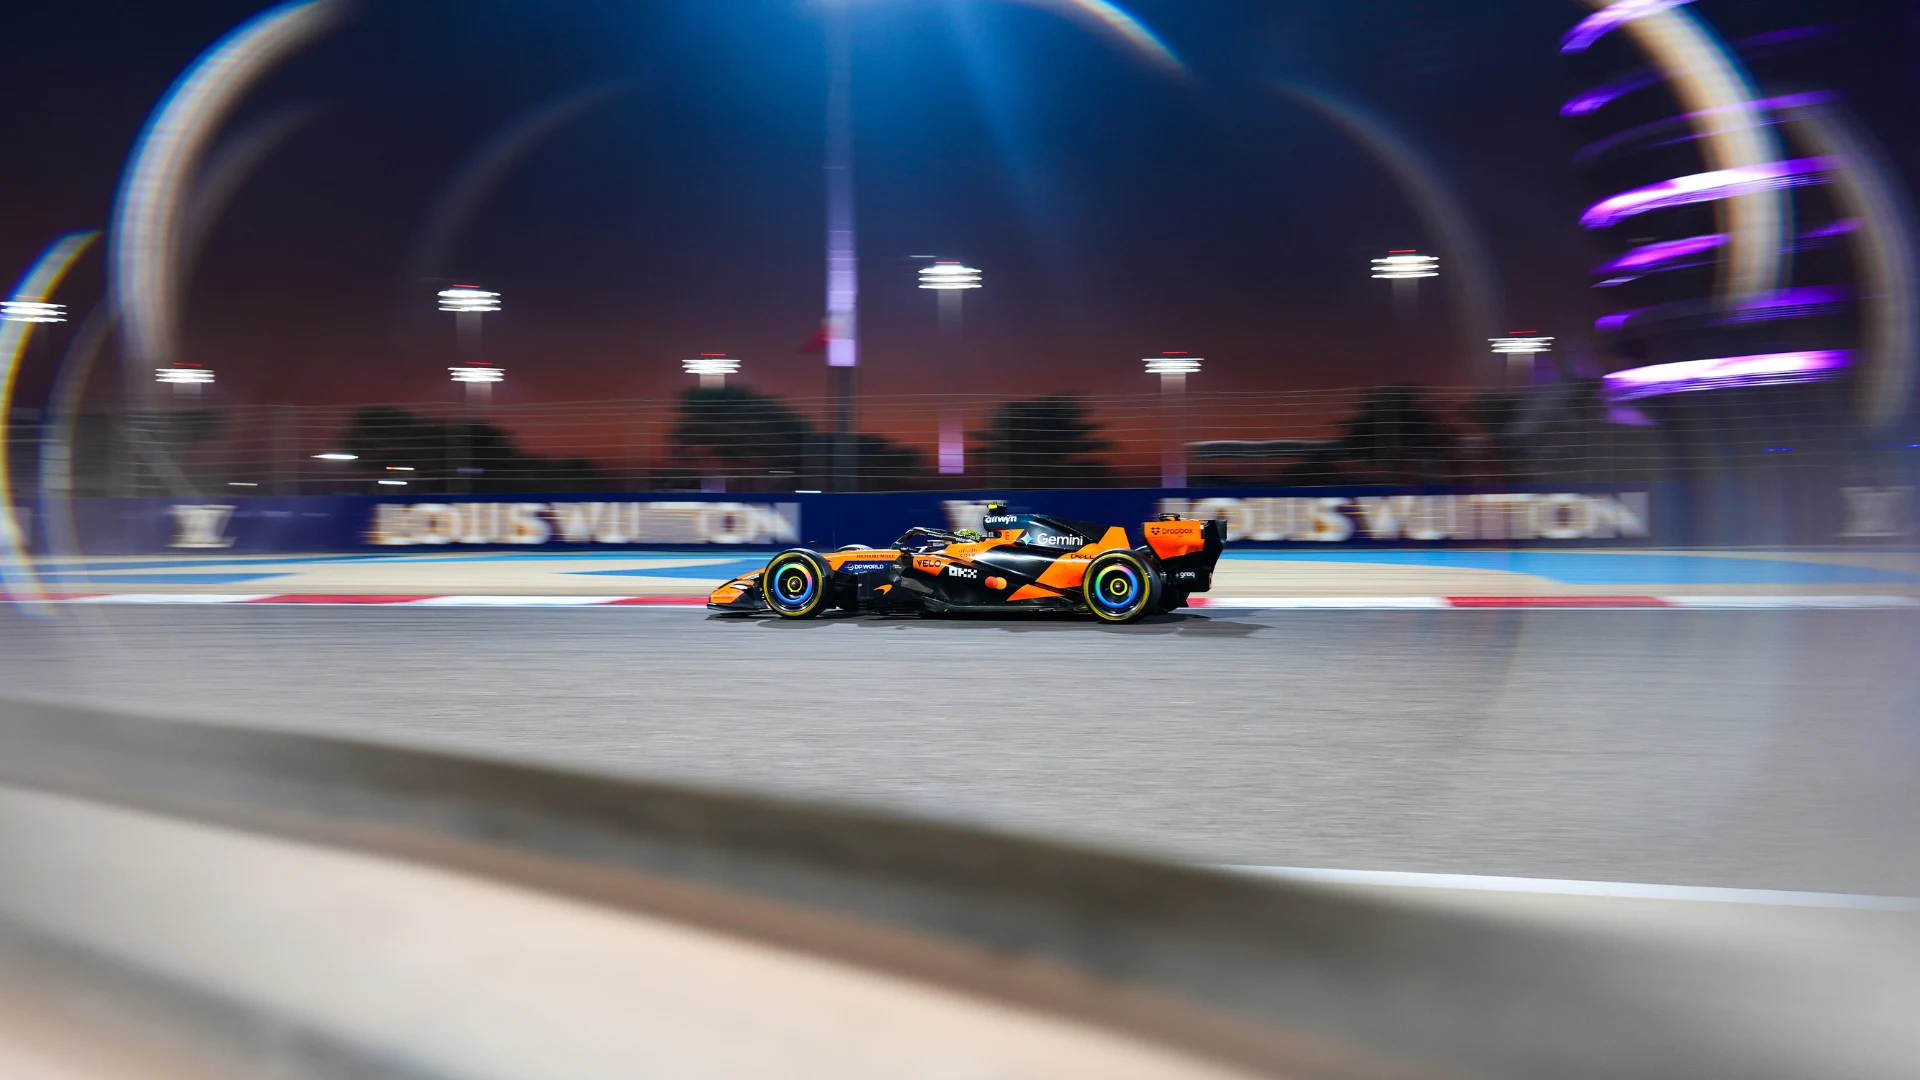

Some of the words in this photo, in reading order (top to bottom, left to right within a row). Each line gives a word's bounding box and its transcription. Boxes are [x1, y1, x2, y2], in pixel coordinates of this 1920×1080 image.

[1037, 533, 1083, 546] Gemini
[917, 559, 942, 568] VELO
[948, 567, 978, 579] OKX
[1179, 571, 1196, 579] groq
